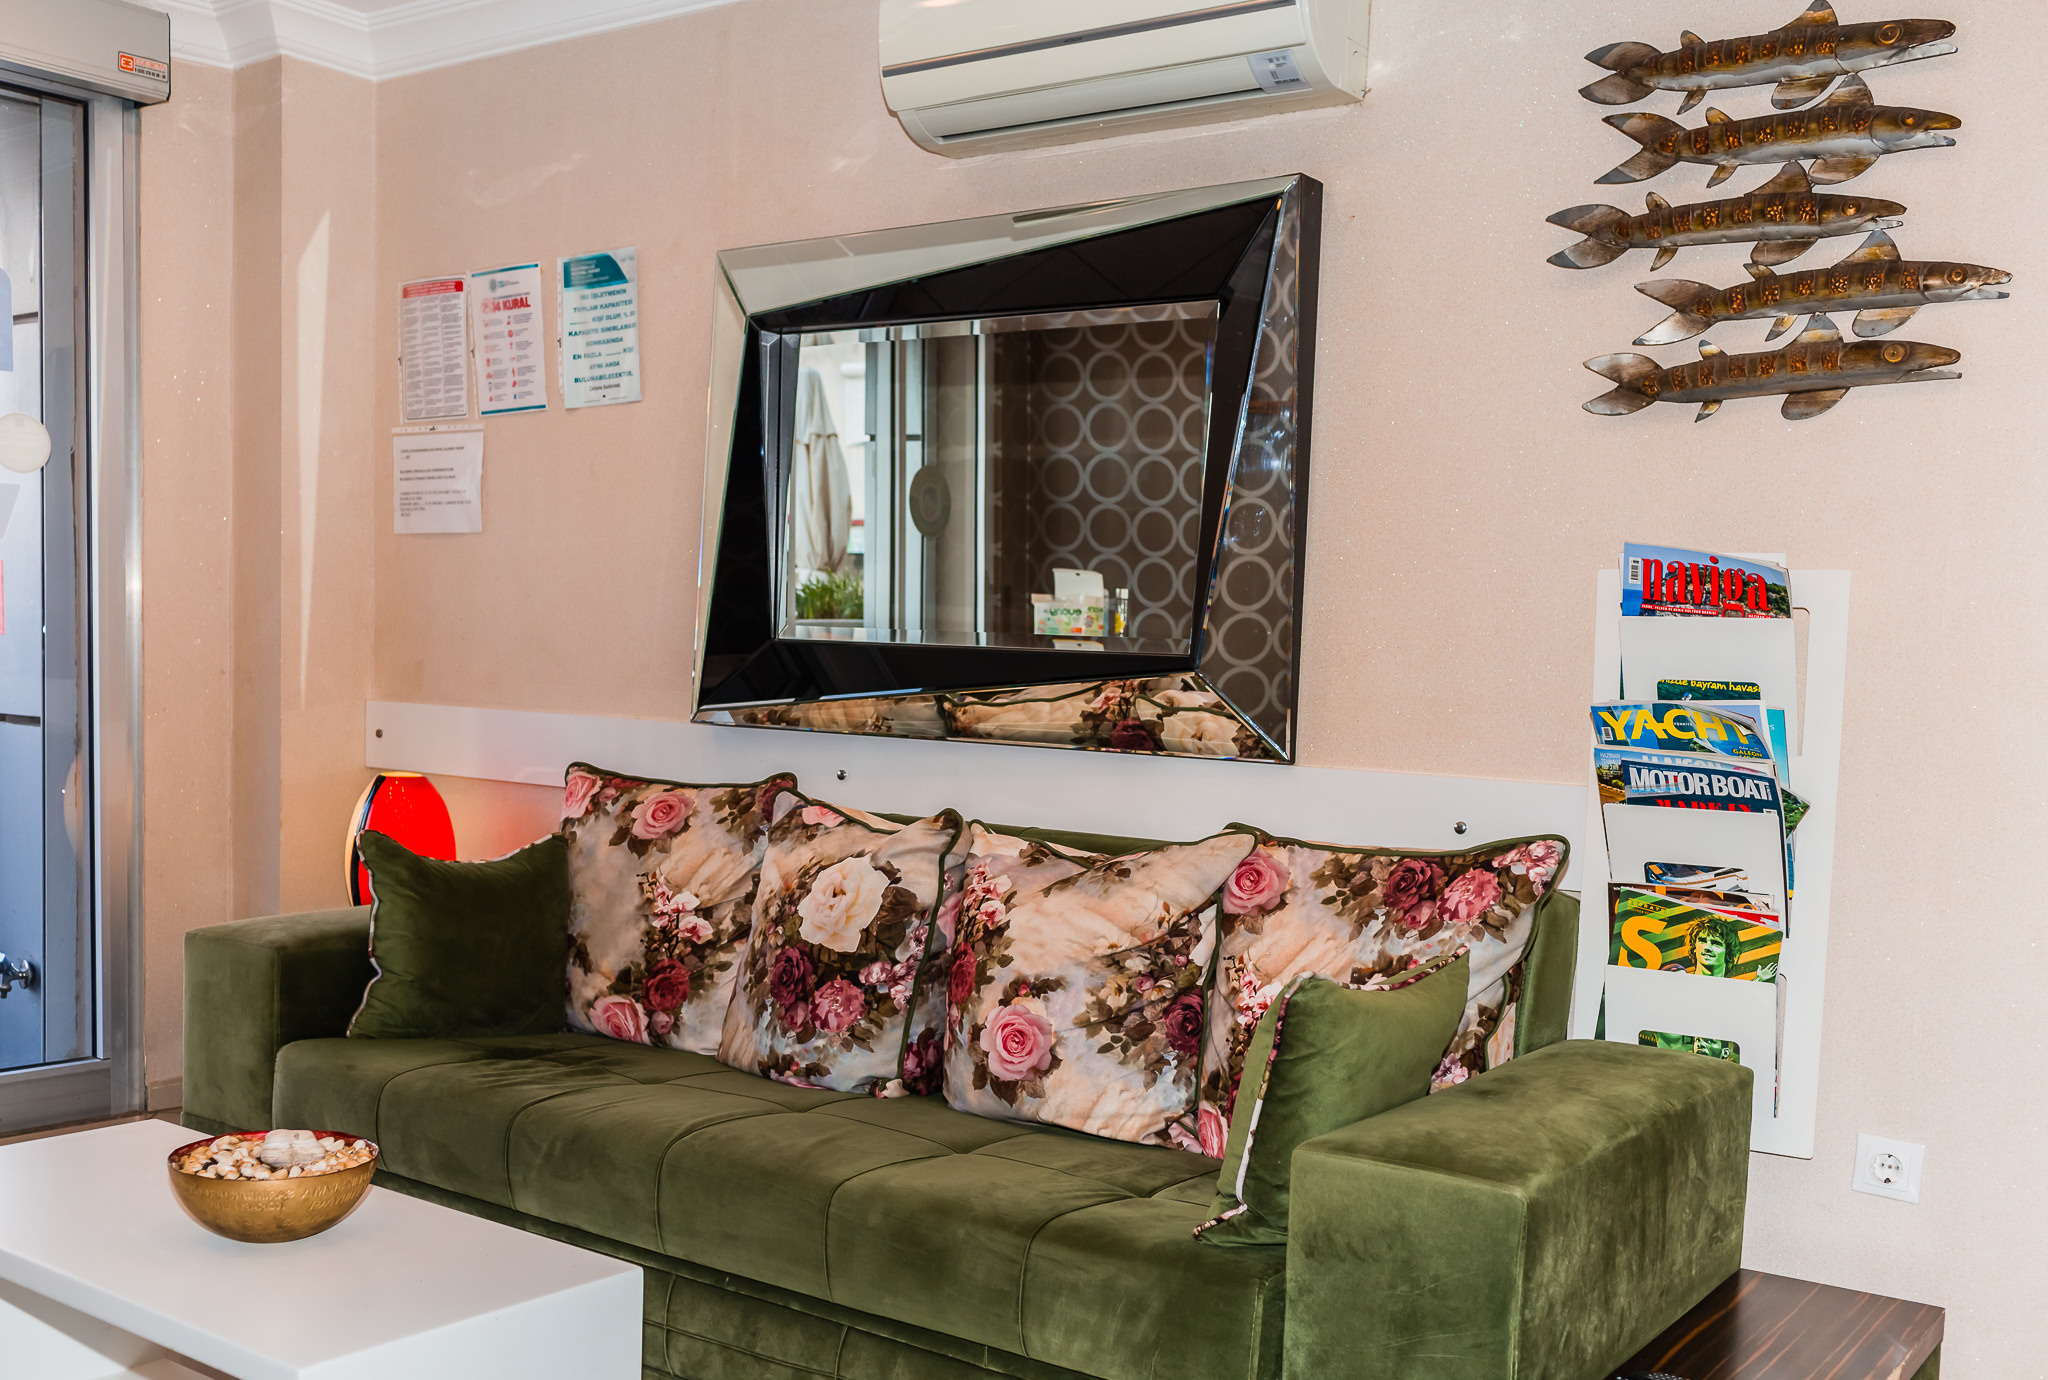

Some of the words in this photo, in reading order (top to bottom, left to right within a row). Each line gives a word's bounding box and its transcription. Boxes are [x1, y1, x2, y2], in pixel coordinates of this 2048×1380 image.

[502, 297, 531, 311] KURAL
[1641, 555, 1772, 618] naviga
[1690, 680, 1727, 691] bayram
[1598, 708, 1749, 745] YACHT
[1732, 748, 1763, 758] GALEON
[1629, 767, 1711, 796] MOTOR
[1711, 774, 1770, 801] BOAT
[1617, 915, 1668, 970] S
